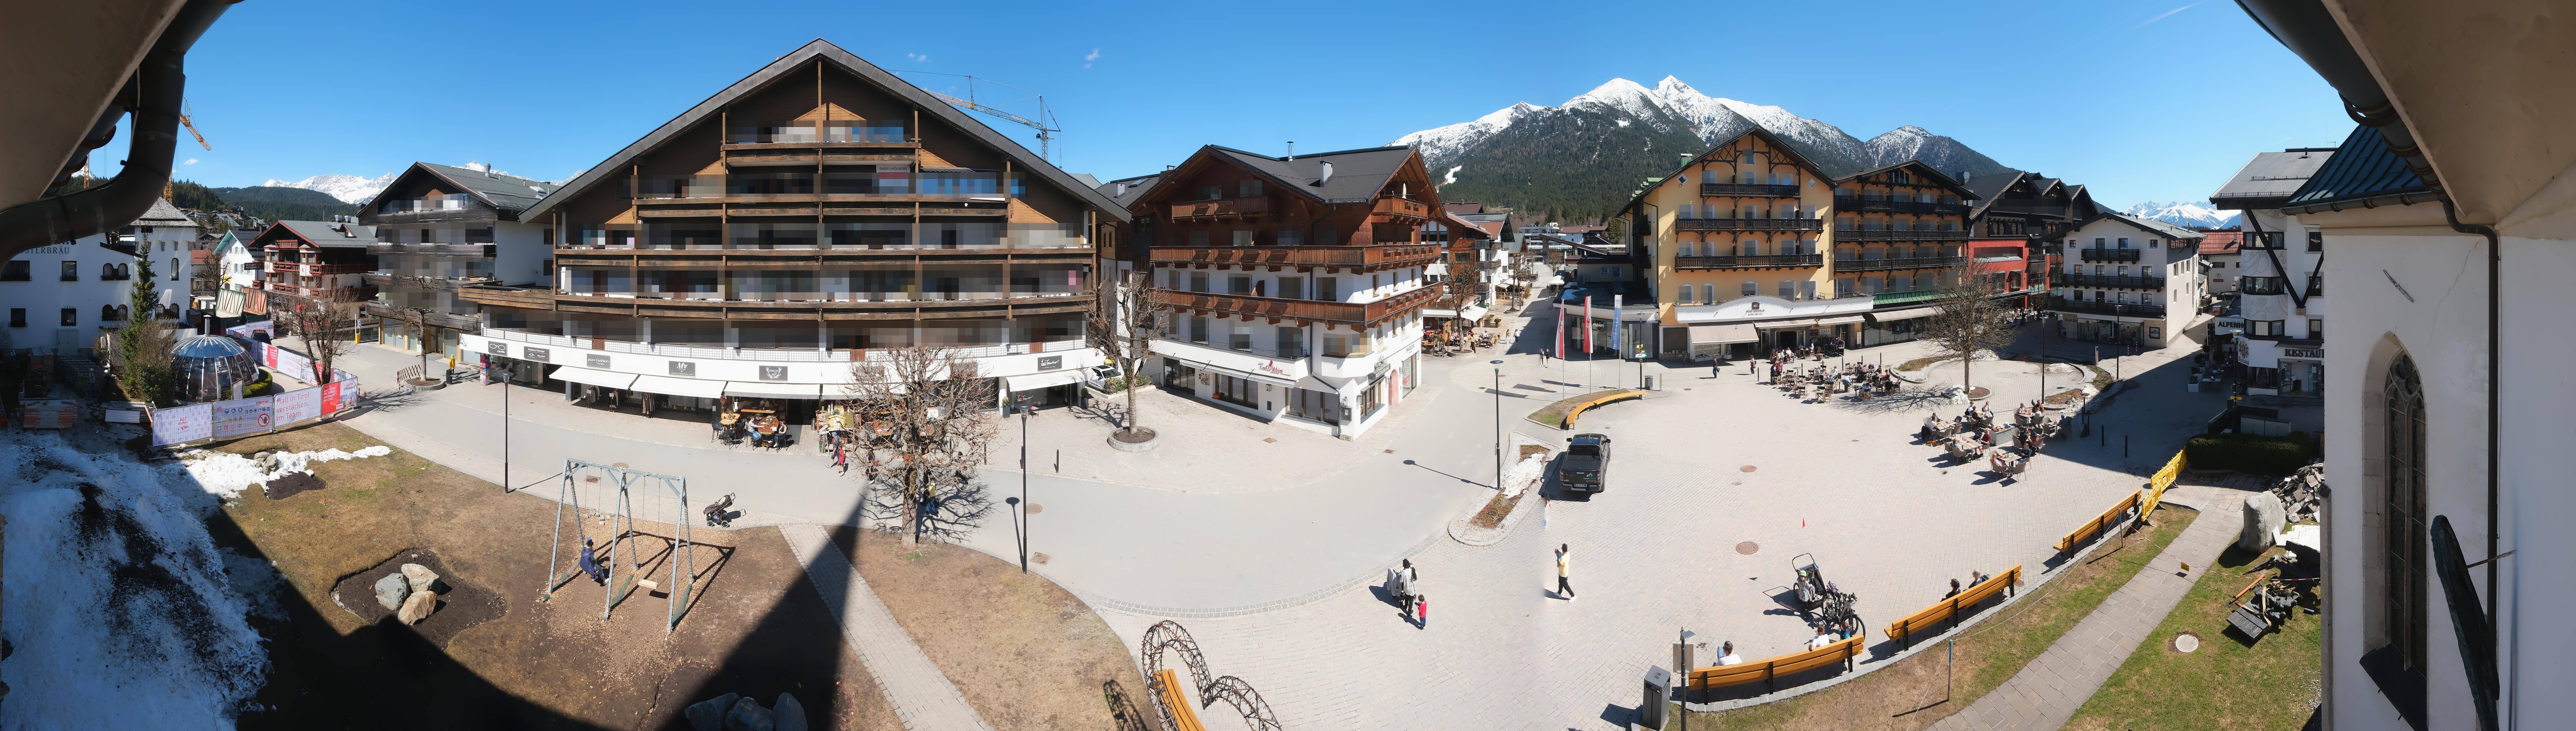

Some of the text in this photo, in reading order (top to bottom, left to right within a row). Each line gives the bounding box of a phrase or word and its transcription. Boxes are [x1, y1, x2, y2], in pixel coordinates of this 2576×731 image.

[1406, 344, 1414, 352] SAILER
[676, 362, 688, 372] My
[1376, 365, 1390, 378] RESTAURANT
[277, 396, 288, 405] Hall
[297, 392, 309, 400] Tirol
[277, 402, 309, 413] verstärken.
